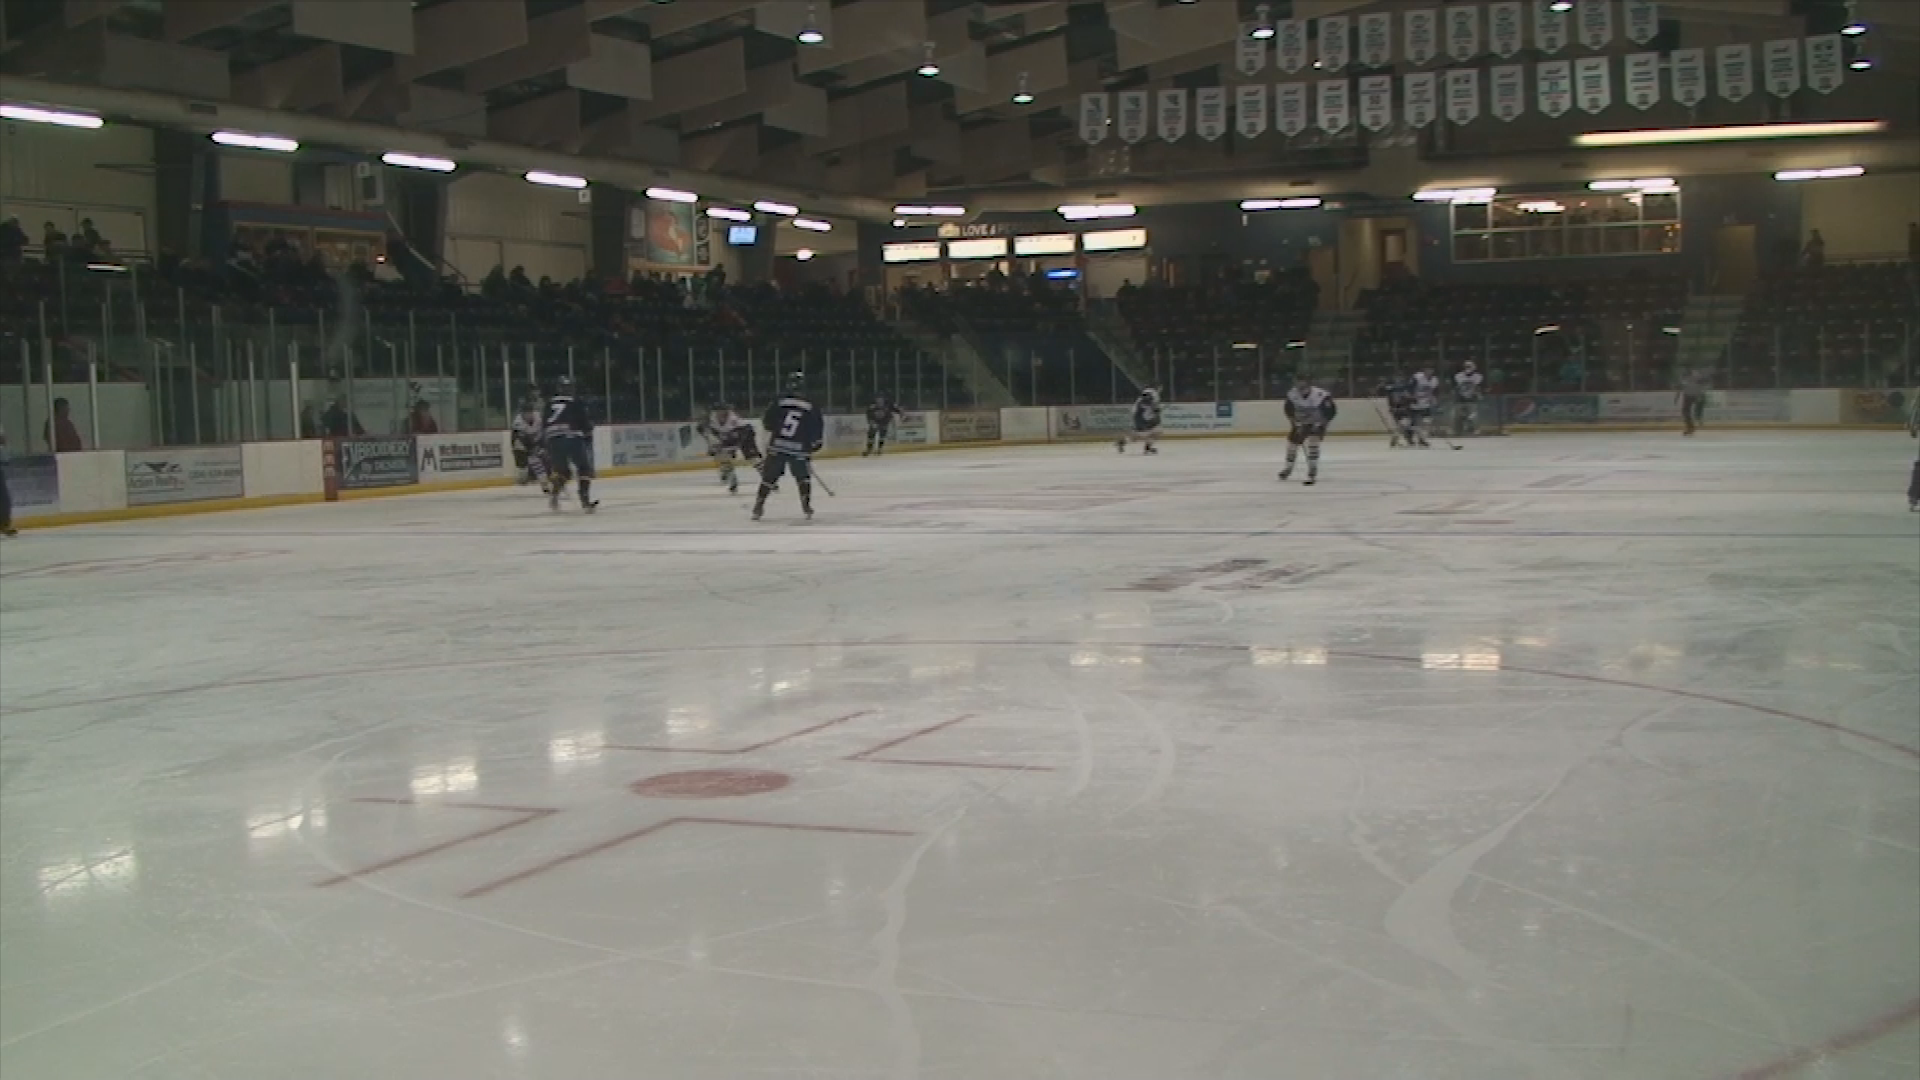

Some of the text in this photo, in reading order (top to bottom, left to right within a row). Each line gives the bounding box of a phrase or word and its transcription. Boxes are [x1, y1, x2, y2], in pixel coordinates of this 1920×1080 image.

[962, 223, 988, 236] LOVE
[547, 403, 567, 423] 7
[780, 410, 803, 437] 5
